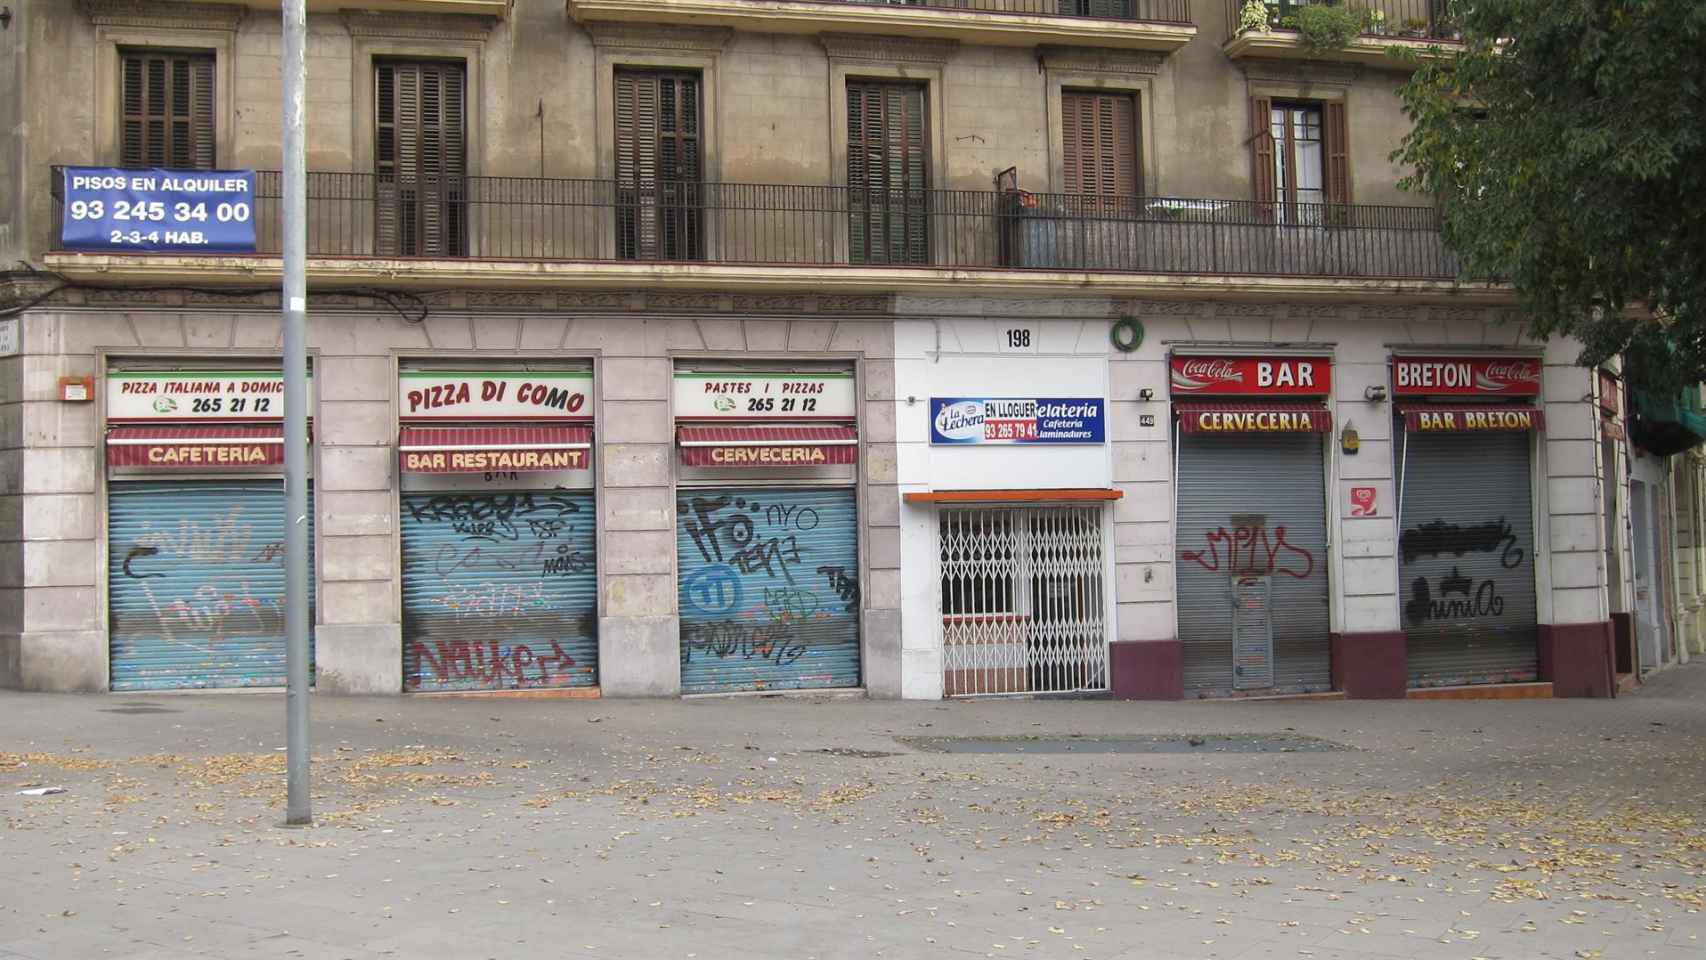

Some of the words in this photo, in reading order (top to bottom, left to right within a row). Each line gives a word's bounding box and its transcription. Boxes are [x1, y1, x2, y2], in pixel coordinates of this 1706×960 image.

[72, 176, 126, 190] PISOS
[131, 178, 156, 190] EN
[161, 178, 248, 192] ALQUILER
[70, 200, 104, 220] 93
[113, 201, 165, 221] 245
[173, 202, 208, 222] 34
[216, 202, 250, 222] 00
[110, 230, 159, 244] 2-3-4
[164, 231, 208, 245] HAB.
[1006, 329, 1031, 348] 198
[1257, 362, 1313, 387] BAR
[1398, 363, 1472, 387] BRETON
[121, 382, 158, 394] PIZZA
[163, 381, 221, 394] ITALIANA
[226, 382, 236, 393] A
[241, 381, 284, 394] DOMIC
[704, 382, 752, 394] PASTES
[765, 383, 769, 393] I
[782, 382, 825, 394] PIZZAS
[407, 382, 470, 413] PIZZA
[481, 381, 506, 402] DI
[516, 383, 585, 413] COMO
[747, 398, 774, 412] 265
[781, 398, 795, 412] 21
[802, 398, 817, 412] 12
[192, 398, 222, 413] 265
[229, 398, 246, 413] 21
[253, 398, 271, 413] 12
[985, 402, 996, 417] EN
[998, 402, 1036, 418] LLOGUER
[1034, 403, 1098, 418] elateria
[943, 414, 985, 431] Lechera
[1043, 420, 1083, 429] Cafeteria
[1200, 412, 1312, 430] CERVECERIA
[1420, 413, 1456, 429] BAR
[1465, 412, 1532, 429] BRETON
[985, 423, 996, 438] 93
[998, 423, 1013, 438] 265
[1015, 423, 1025, 438] 79
[1036, 430, 1092, 439] laminadures
[148, 447, 266, 463] CAFETERIA
[407, 454, 446, 469] BAR
[452, 452, 581, 468] RESTAURANT
[711, 448, 825, 462] CERVECERIA
